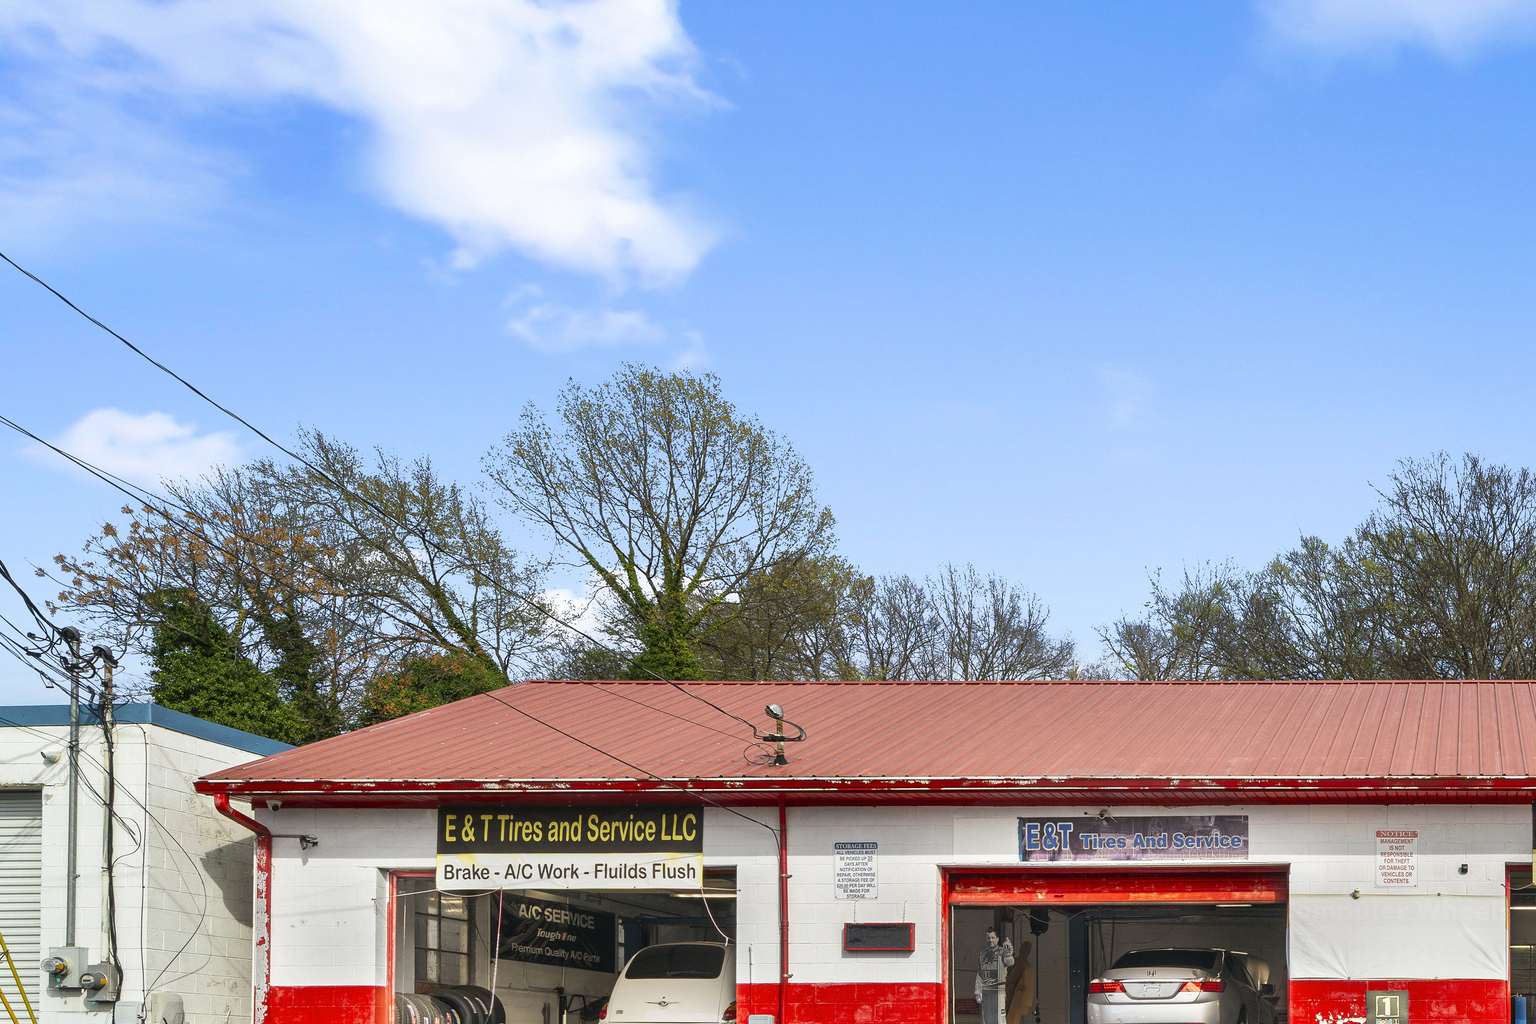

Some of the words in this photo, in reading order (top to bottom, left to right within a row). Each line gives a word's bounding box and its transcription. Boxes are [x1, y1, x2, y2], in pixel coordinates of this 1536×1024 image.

[446, 814, 456, 842] E
[462, 814, 475, 842] &
[480, 814, 493, 842] T
[497, 814, 543, 842] Tires
[548, 814, 582, 842] and
[587, 814, 656, 842] Service
[661, 813, 697, 841] LLC
[1026, 823, 1073, 850] E&T
[1080, 833, 1127, 849] Tires
[1133, 833, 1167, 849] And
[1172, 832, 1242, 849] Service
[444, 864, 490, 880] Brake
[504, 864, 533, 880] A/C
[537, 863, 580, 880] Work
[594, 863, 647, 880] Fluilds
[652, 863, 696, 879] Flush
[518, 903, 543, 920] A/C
[543, 907, 595, 930] SERVICE
[511, 942, 543, 957] Premium
[544, 946, 569, 961] Quality
[570, 948, 582, 961] A/C
[583, 951, 601, 964] Parts
[1382, 997, 1391, 1016] 1
